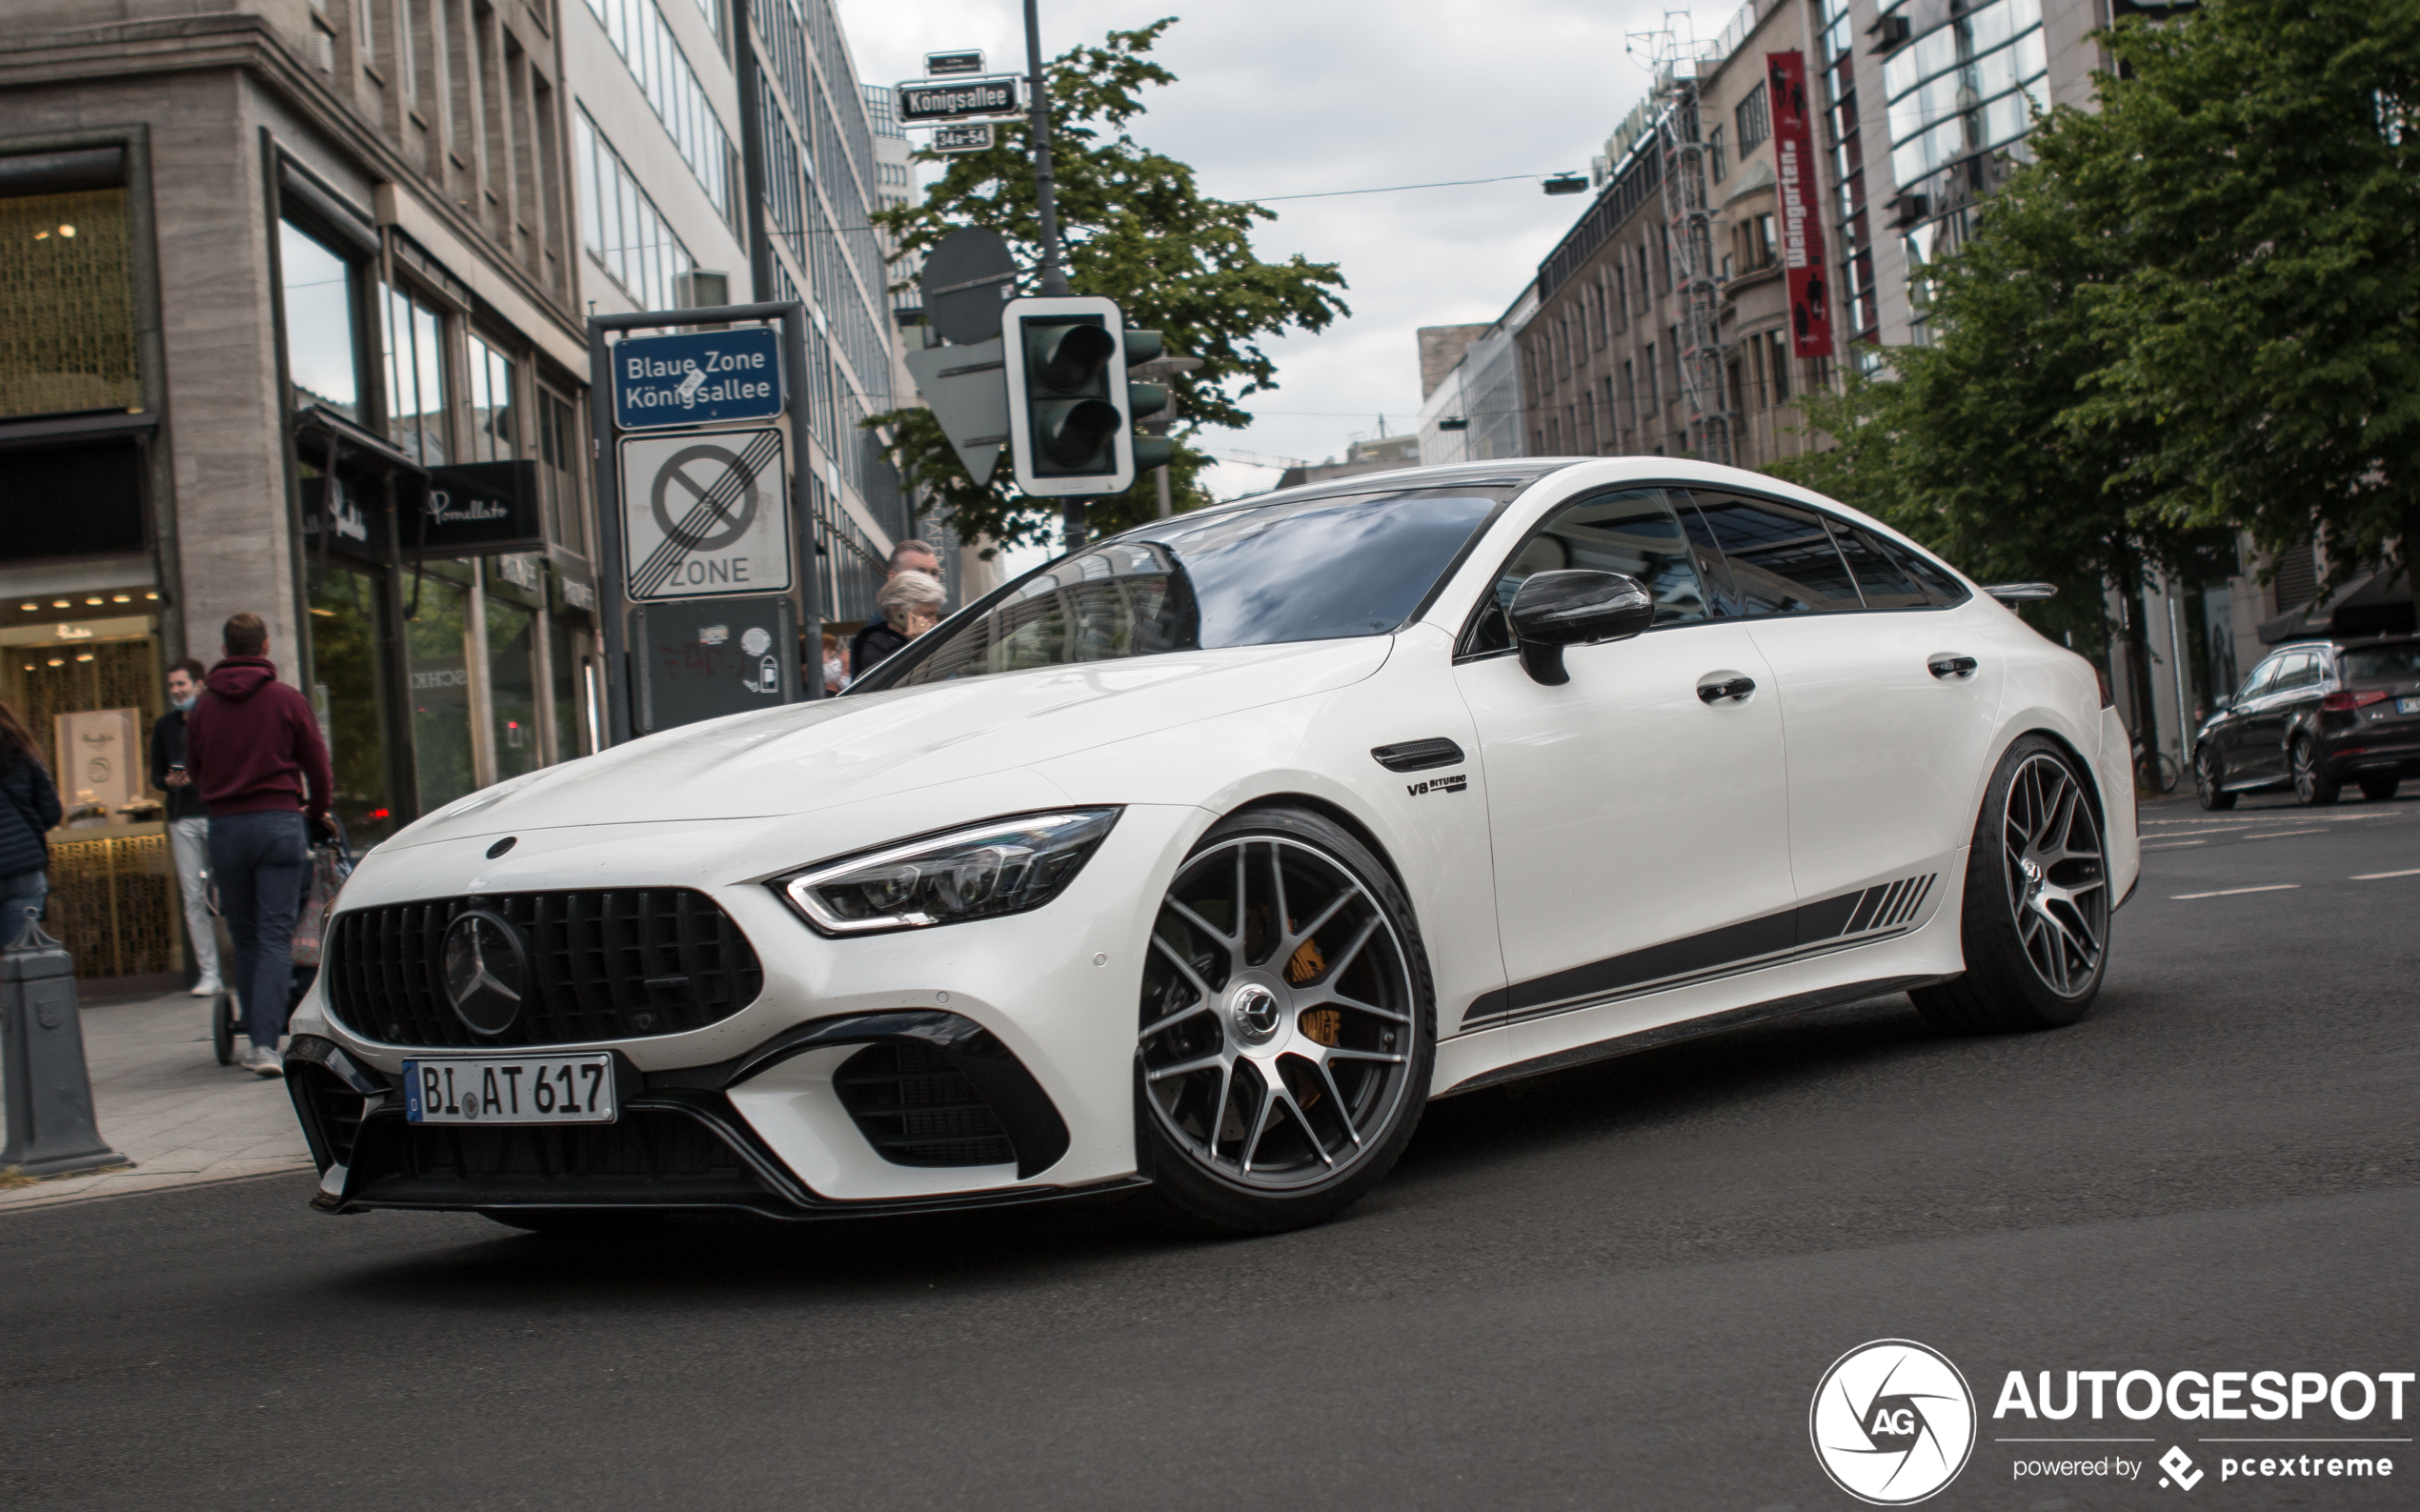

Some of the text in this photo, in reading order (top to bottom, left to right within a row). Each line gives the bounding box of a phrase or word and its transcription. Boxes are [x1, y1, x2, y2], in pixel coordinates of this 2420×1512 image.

[909, 88, 1007, 112] Königsallee
[627, 351, 765, 379] Blaue Zone
[428, 491, 509, 524] Pomellato
[669, 557, 750, 587] ZONE
[1407, 775, 1466, 796] V8 BITURBO
[422, 1064, 605, 1115] BI AT 617
